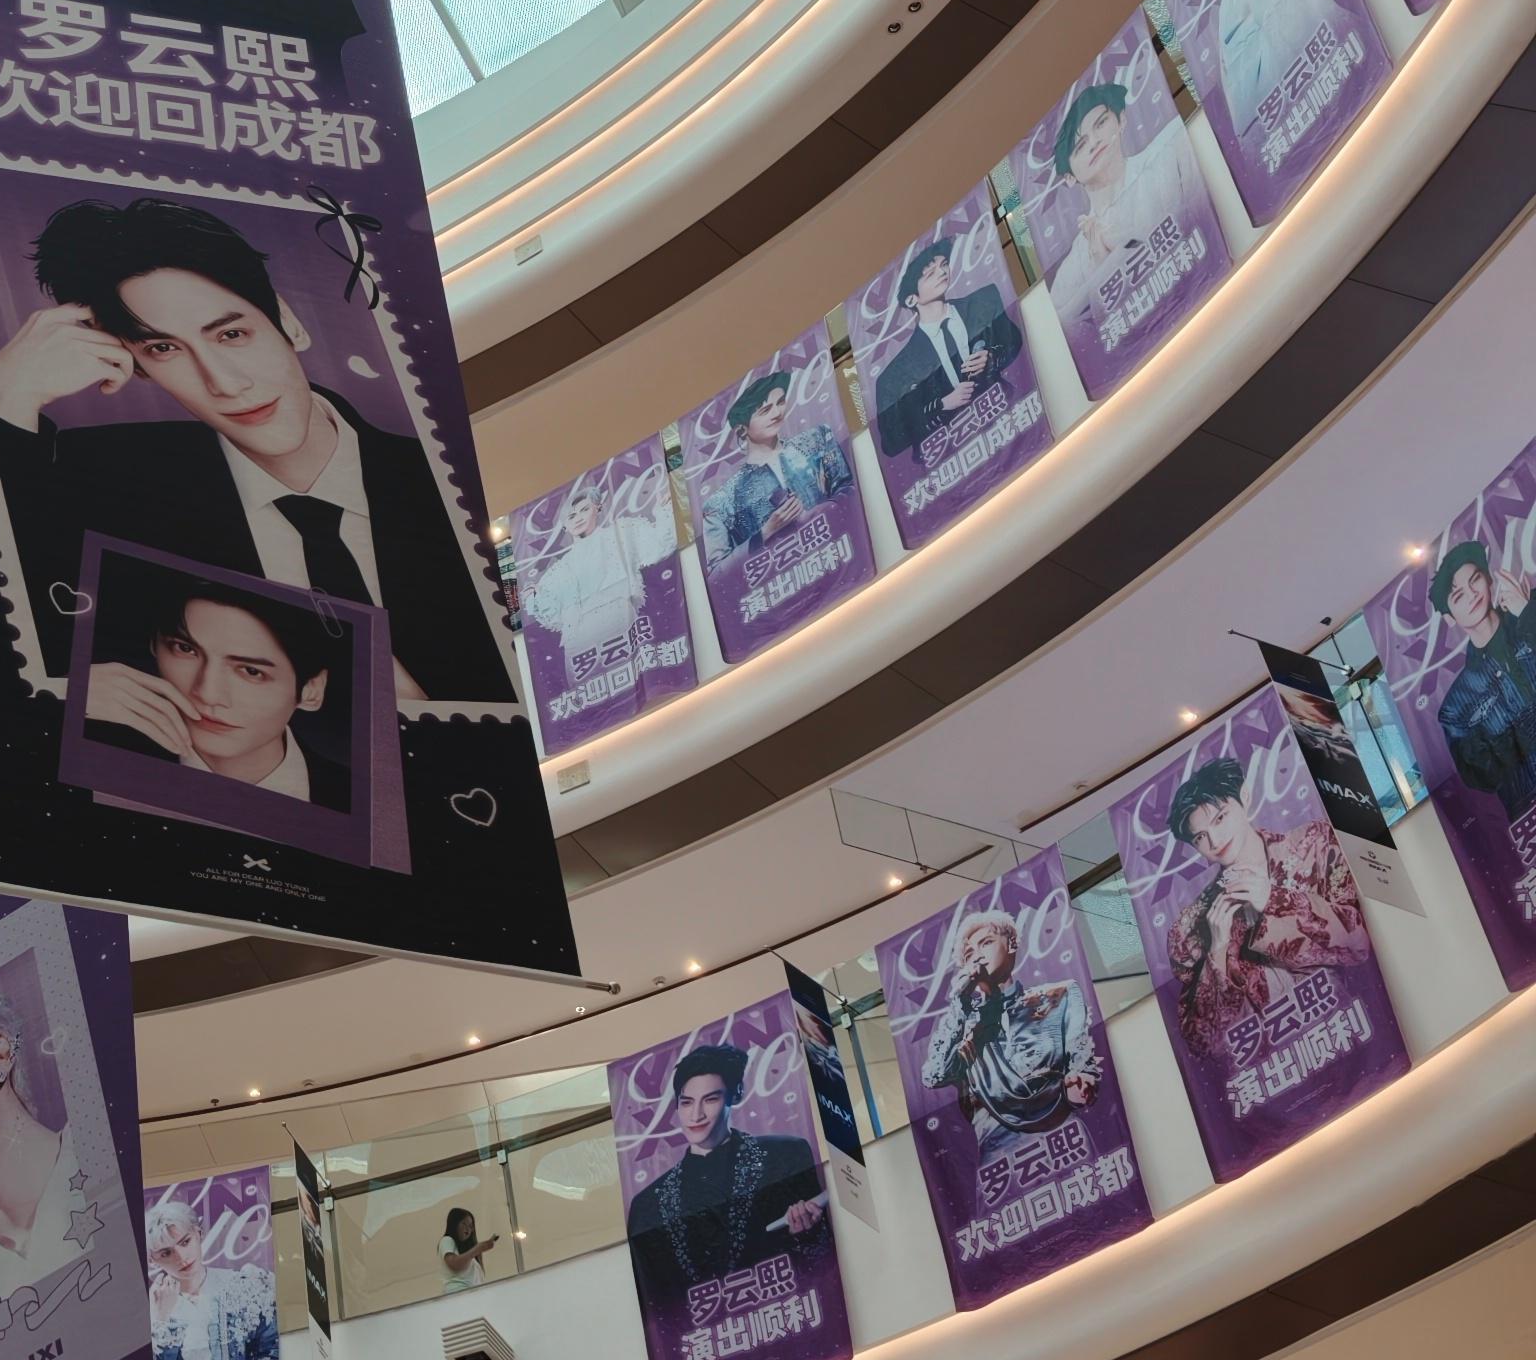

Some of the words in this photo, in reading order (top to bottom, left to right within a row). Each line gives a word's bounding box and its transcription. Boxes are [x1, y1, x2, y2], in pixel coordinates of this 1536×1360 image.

[1256, 22, 1336, 130] 罗云熙
[1261, 32, 1364, 176] 演出顺利
[1099, 216, 1182, 311] 罗云熙
[1100, 228, 1207, 352] 演出顺利
[903, 392, 1042, 515] 欢迎回成都
[920, 382, 1007, 468] 罗云熙
[739, 534, 853, 623] 演出顺利
[743, 514, 830, 587] 罗云熙
[572, 616, 653, 681] 罗云熙
[190, 870, 209, 879] YOU
[245, 880, 264, 889] ONE
[205, 867, 221, 875] ALL
[223, 869, 241, 878] FOR
[266, 878, 283, 888] LUO
[1226, 968, 1336, 1067] 罗云熙
[1226, 1001, 1373, 1120] 演出顺利
[956, 1147, 1134, 1262] 欢迎回成都
[978, 1120, 1087, 1206] 罗云熙
[687, 1253, 796, 1326] 罗云熙
